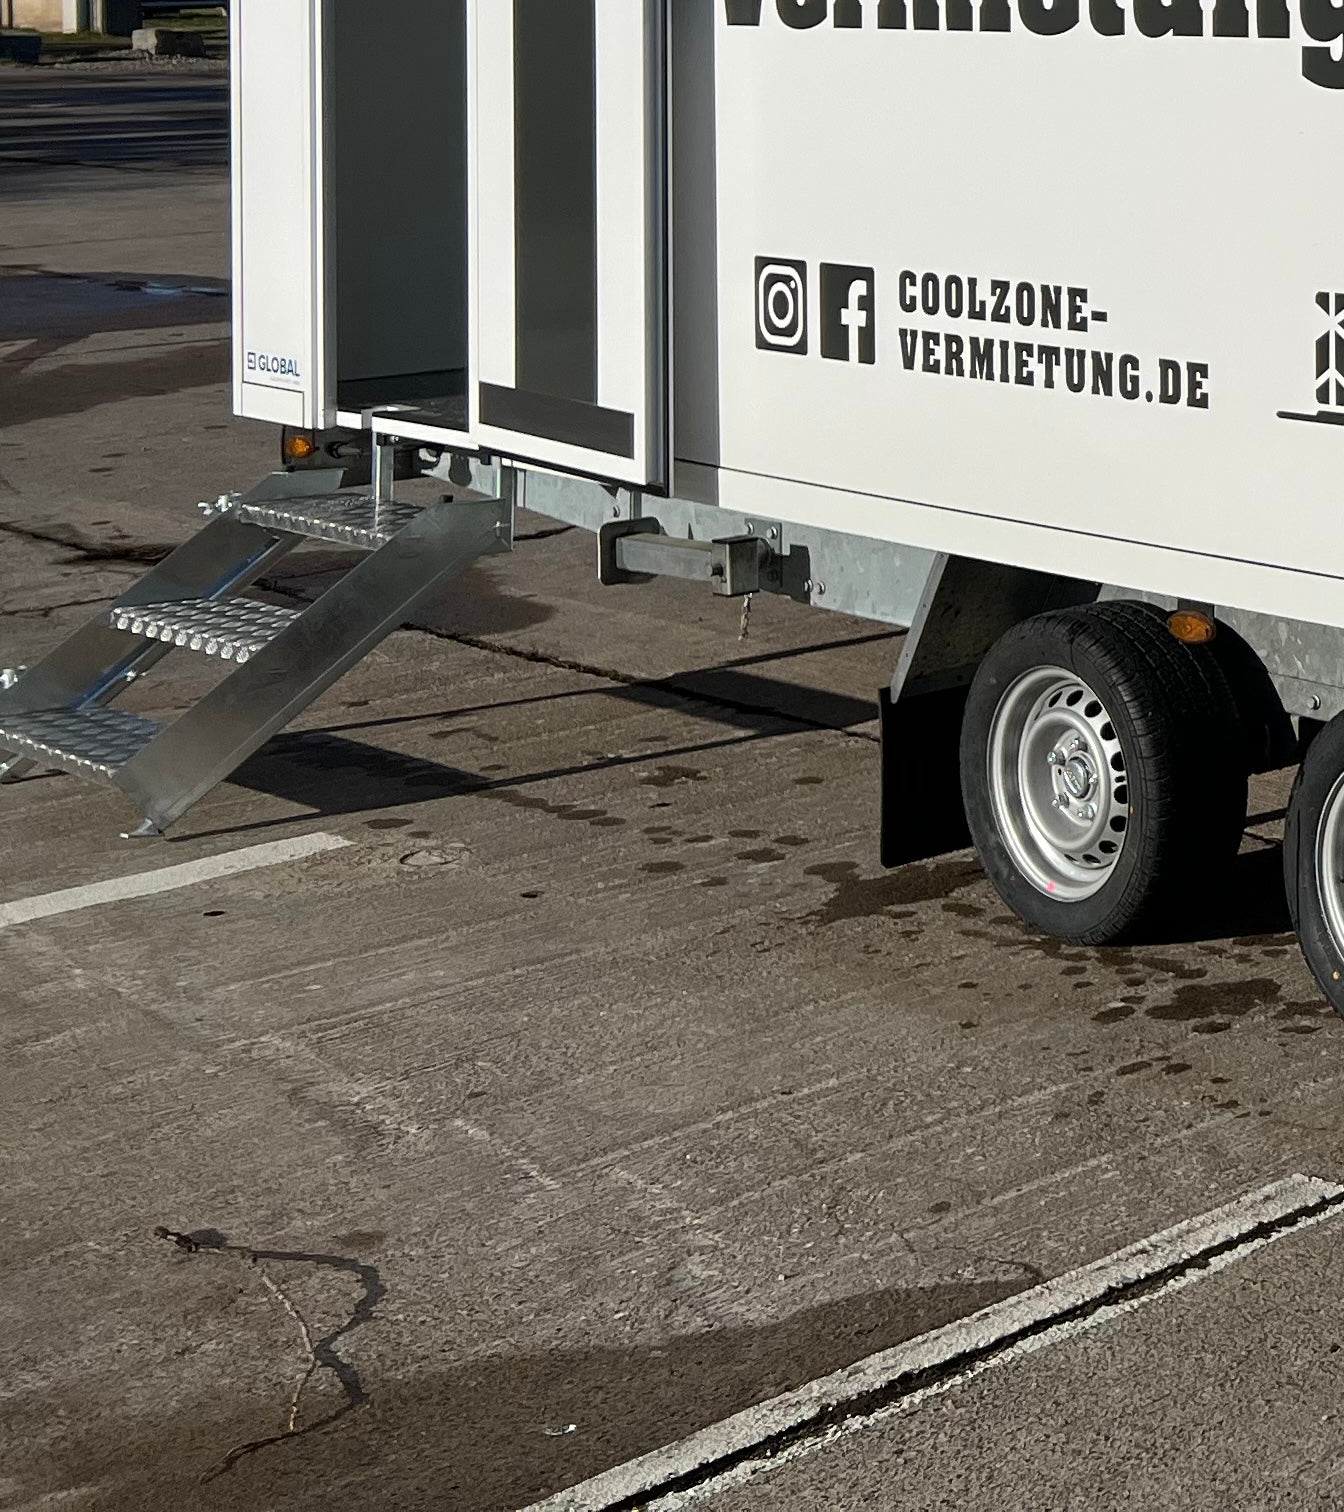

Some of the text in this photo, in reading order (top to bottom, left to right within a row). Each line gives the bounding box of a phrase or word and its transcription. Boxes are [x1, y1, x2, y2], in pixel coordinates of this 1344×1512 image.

[899, 269, 1109, 333] COOLZONE-
[258, 354, 301, 377] GLOBAL
[898, 327, 1210, 410] VERMIETUNG.DE
